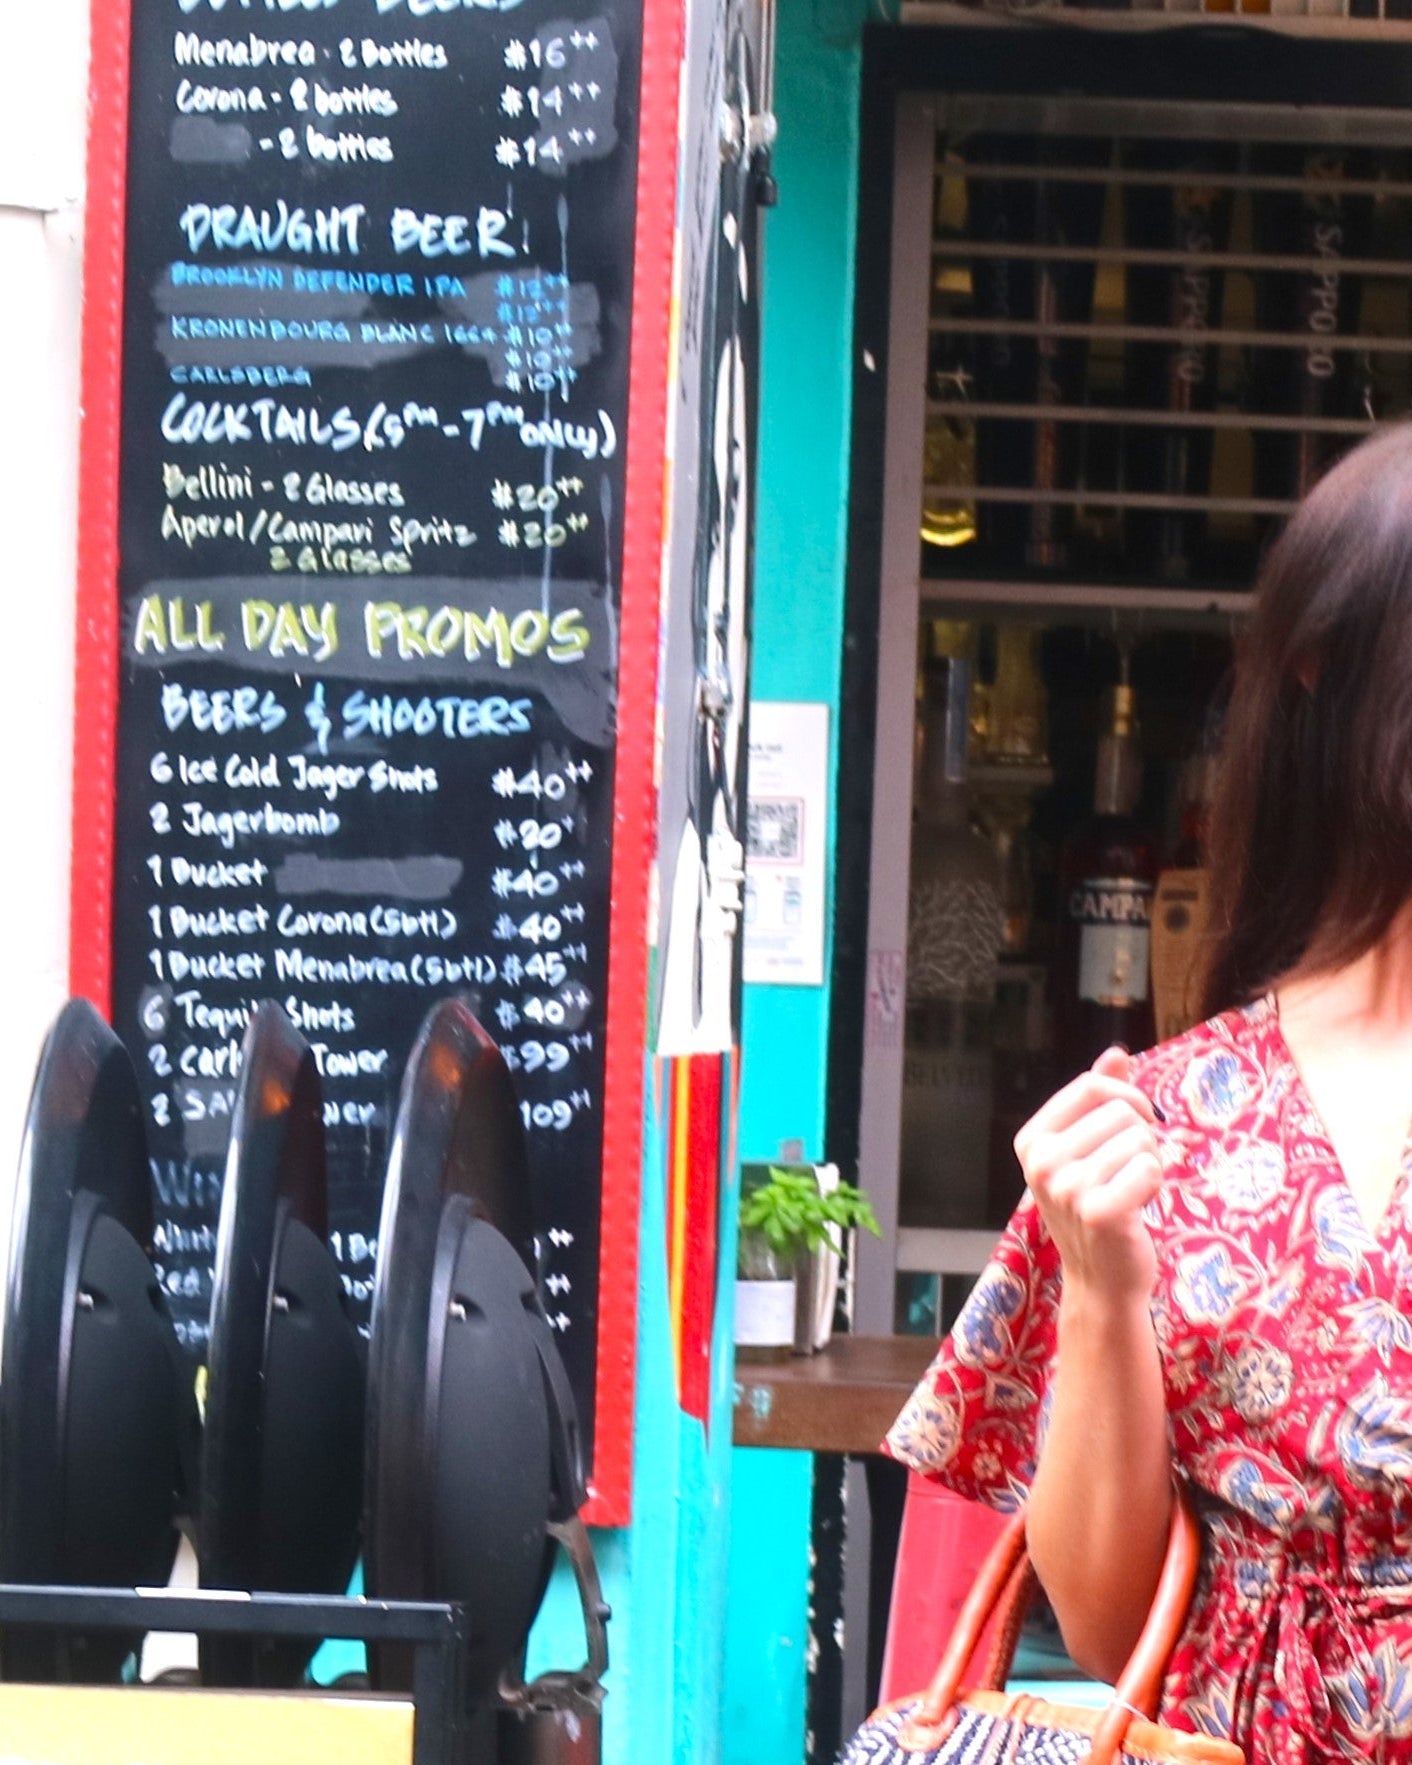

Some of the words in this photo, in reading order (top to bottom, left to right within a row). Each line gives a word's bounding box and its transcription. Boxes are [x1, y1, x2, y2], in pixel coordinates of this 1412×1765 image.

[176, 79, 268, 113] Corona
[180, 198, 366, 255] DRAUGHT
[391, 205, 516, 259] BEER
[172, 261, 283, 290] BROOKLYN
[293, 268, 415, 297] DEFENDER
[424, 273, 468, 299] IPA
[172, 315, 351, 342] KRONENBOURG
[361, 320, 435, 345] BLANC
[170, 364, 312, 388] CARLSBERG
[163, 461, 253, 500] Bellini
[306, 471, 405, 506] Glasses
[134, 593, 227, 655] ALL
[241, 599, 339, 663] DAY
[364, 601, 591, 669] PROMOS
[161, 682, 287, 735] BEERS
[342, 688, 533, 741] SHOOTERS
[150, 751, 174, 784] 6
[178, 754, 219, 786] Ice
[224, 752, 281, 788] Cold
[143, 993, 166, 1032] 6
